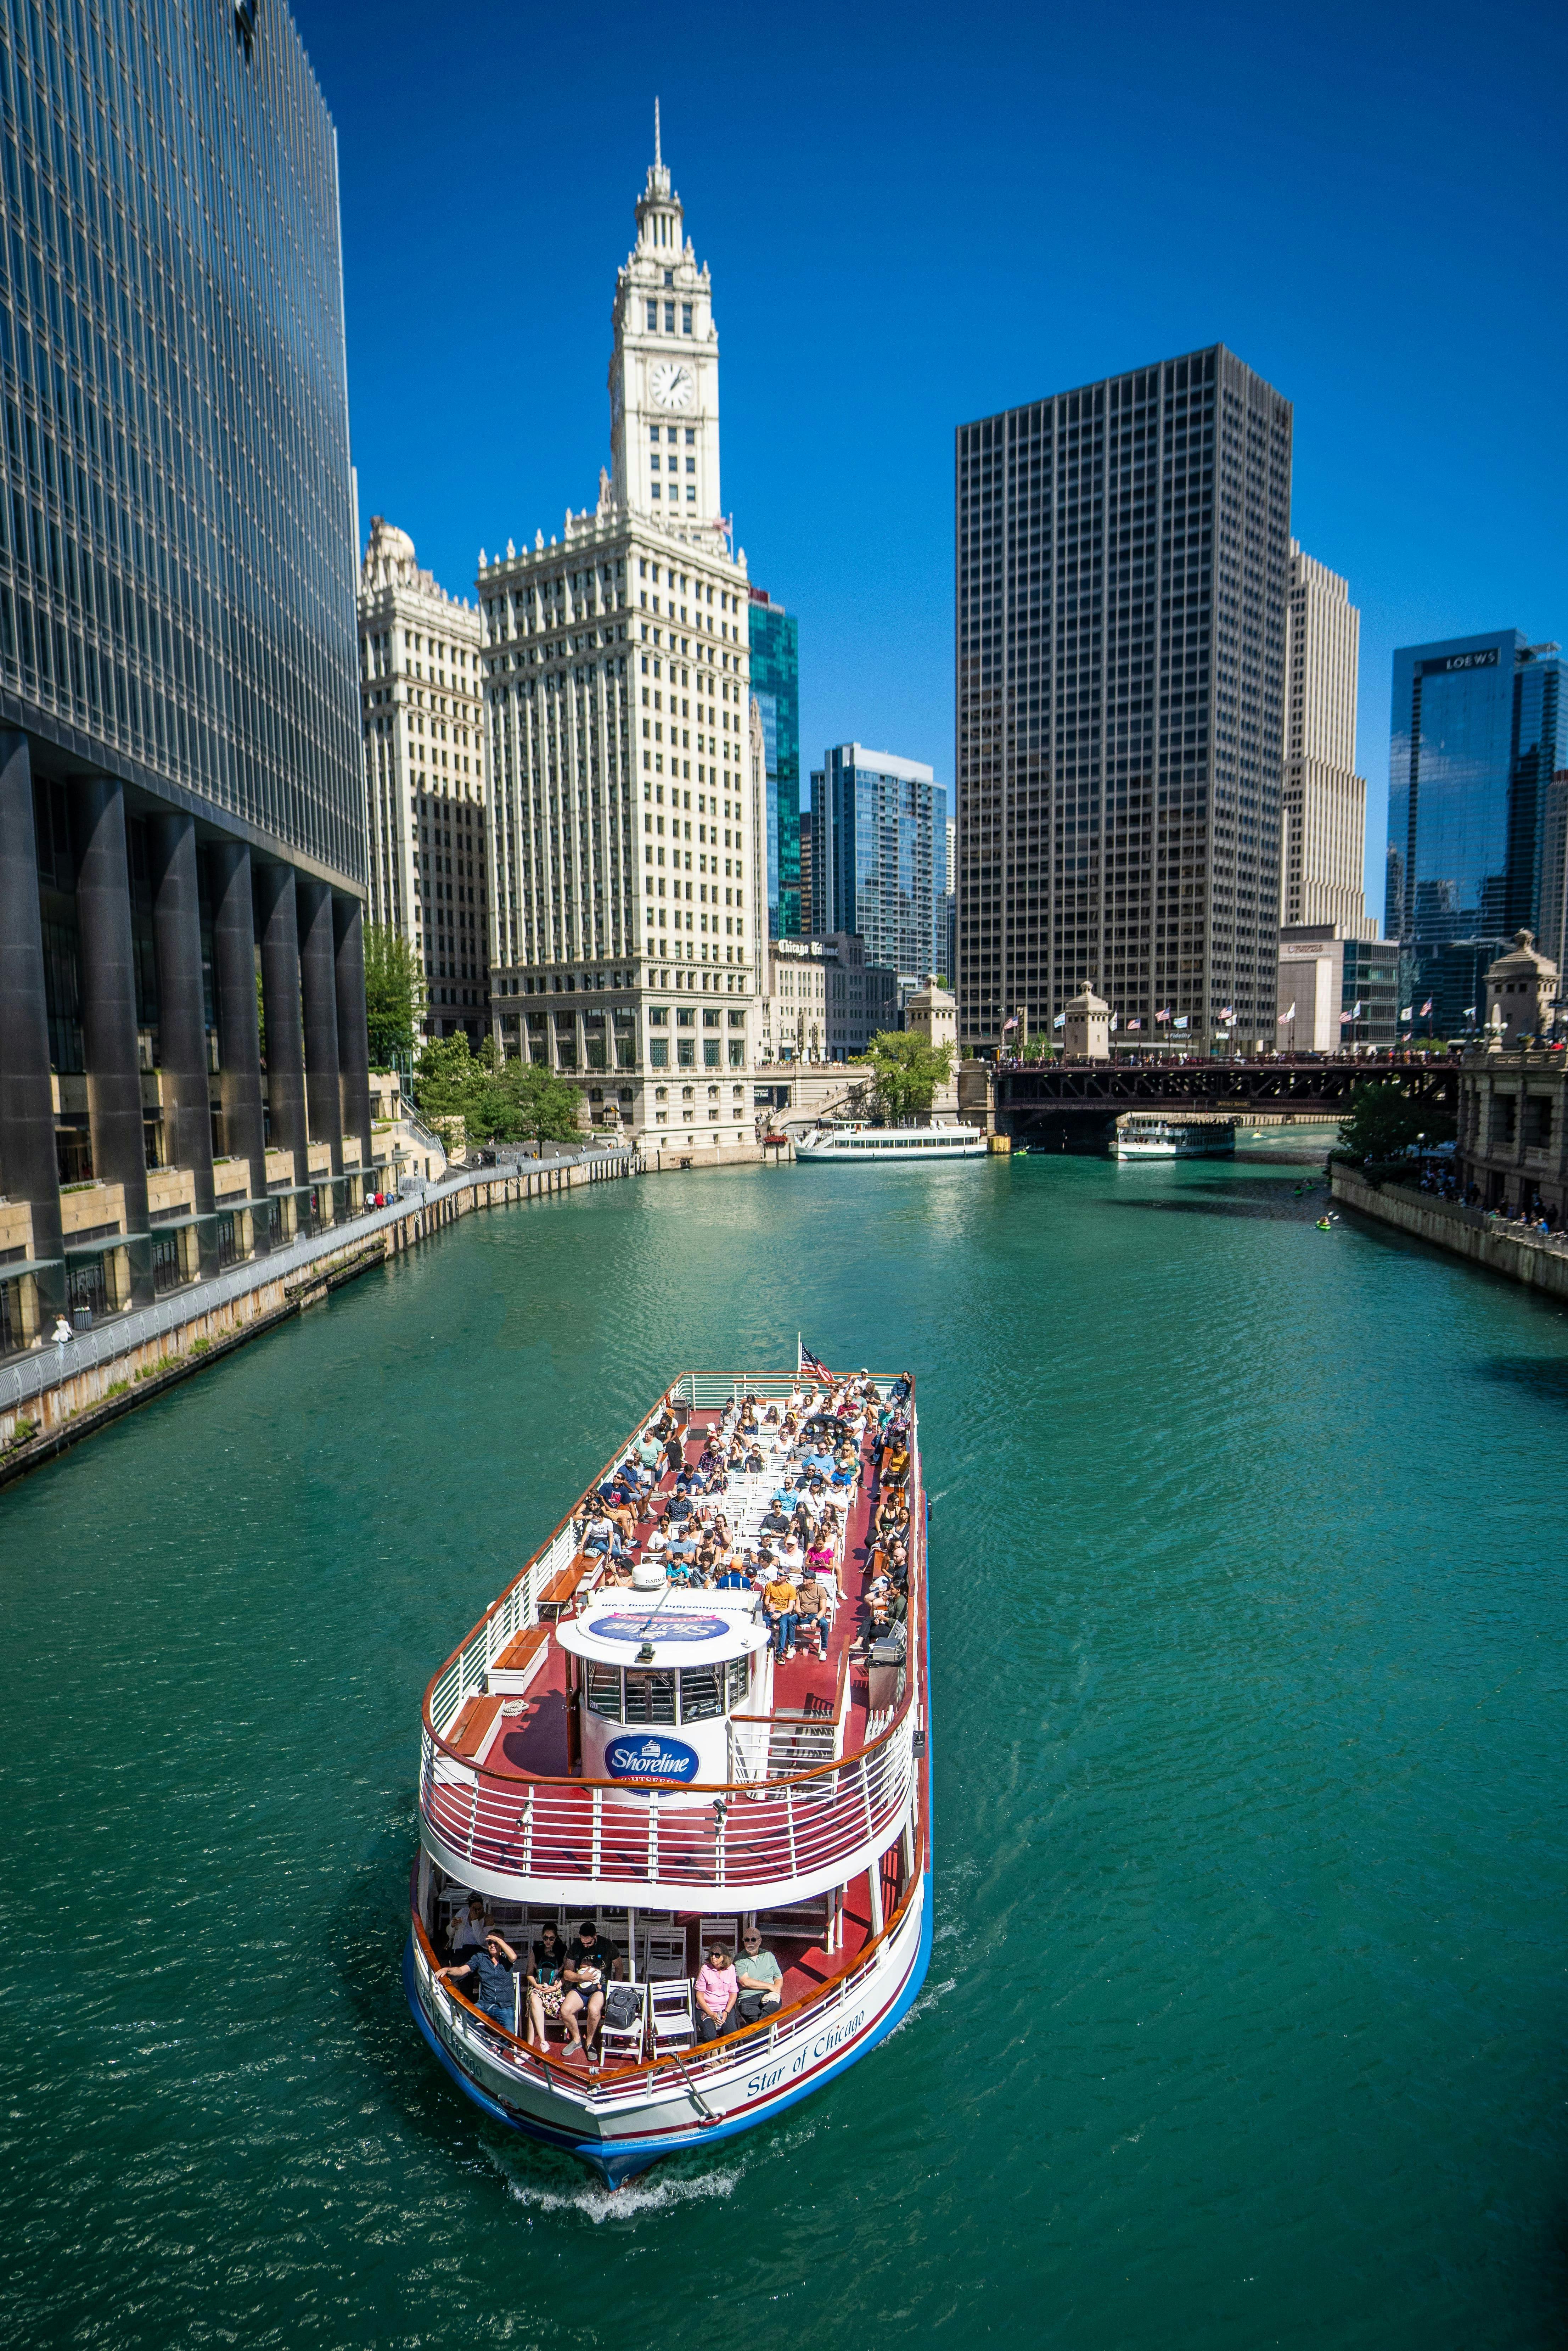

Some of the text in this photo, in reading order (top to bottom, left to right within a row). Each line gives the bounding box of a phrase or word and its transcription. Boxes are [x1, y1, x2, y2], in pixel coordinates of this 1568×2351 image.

[1446, 651, 1495, 670] LOEWS
[778, 939, 839, 956] Chicago Tribune
[602, 1622, 717, 1636] Shoreline
[612, 1749, 690, 1773] Shoreline
[444, 2024, 482, 2077] Chicago
[747, 2010, 864, 2097] Star of Chicago
